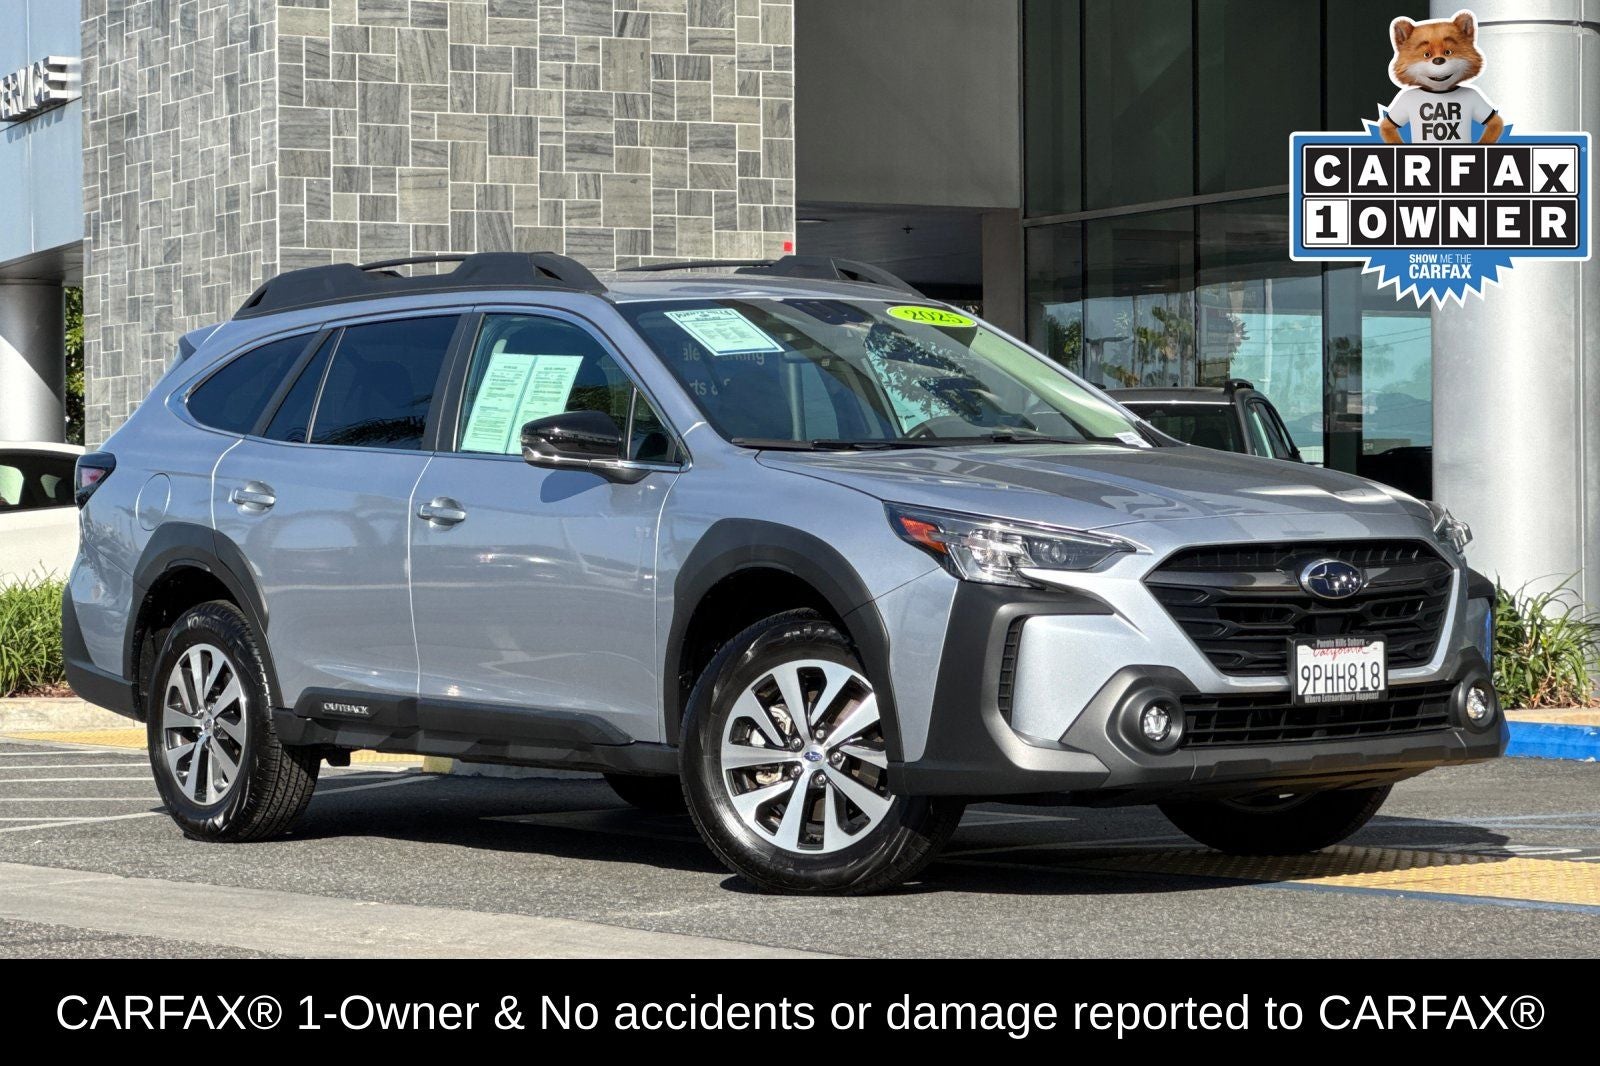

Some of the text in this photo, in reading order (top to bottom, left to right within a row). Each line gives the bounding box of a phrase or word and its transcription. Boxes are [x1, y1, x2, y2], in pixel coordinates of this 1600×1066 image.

[0, 55, 80, 119] ERVICE
[904, 309, 964, 324] 2025
[1301, 661, 1381, 695] 9PHH818
[323, 702, 370, 715] OUTBACK
